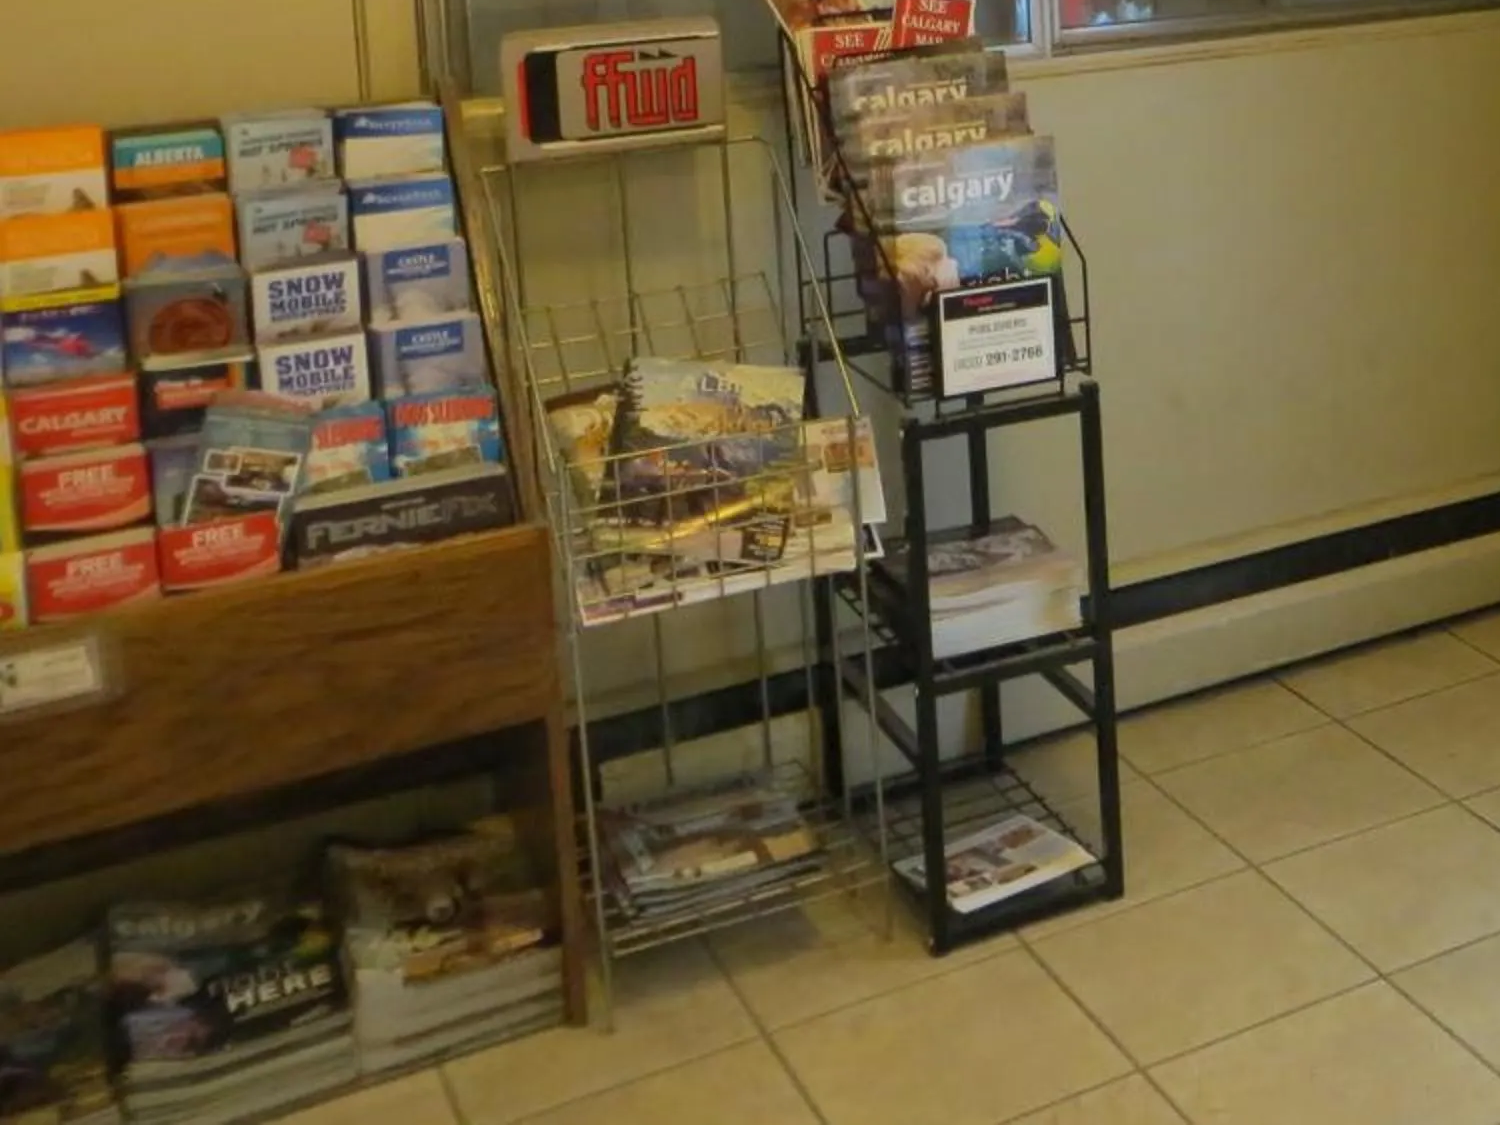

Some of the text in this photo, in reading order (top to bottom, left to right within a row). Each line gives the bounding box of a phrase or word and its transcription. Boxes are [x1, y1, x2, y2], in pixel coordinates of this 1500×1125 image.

[902, 15, 960, 33] CALGARY
[835, 33, 864, 48] SEE
[134, 145, 204, 166] ALBERTA
[902, 172, 1014, 209] calgary
[268, 272, 345, 300] SNOW
[269, 291, 347, 315] MOBILE
[276, 345, 354, 373] SNOW
[278, 366, 354, 391] MOBILE
[18, 406, 128, 435] CALGARY
[58, 463, 114, 489] FREE
[192, 522, 245, 547] FREE
[67, 551, 123, 577] FREE
